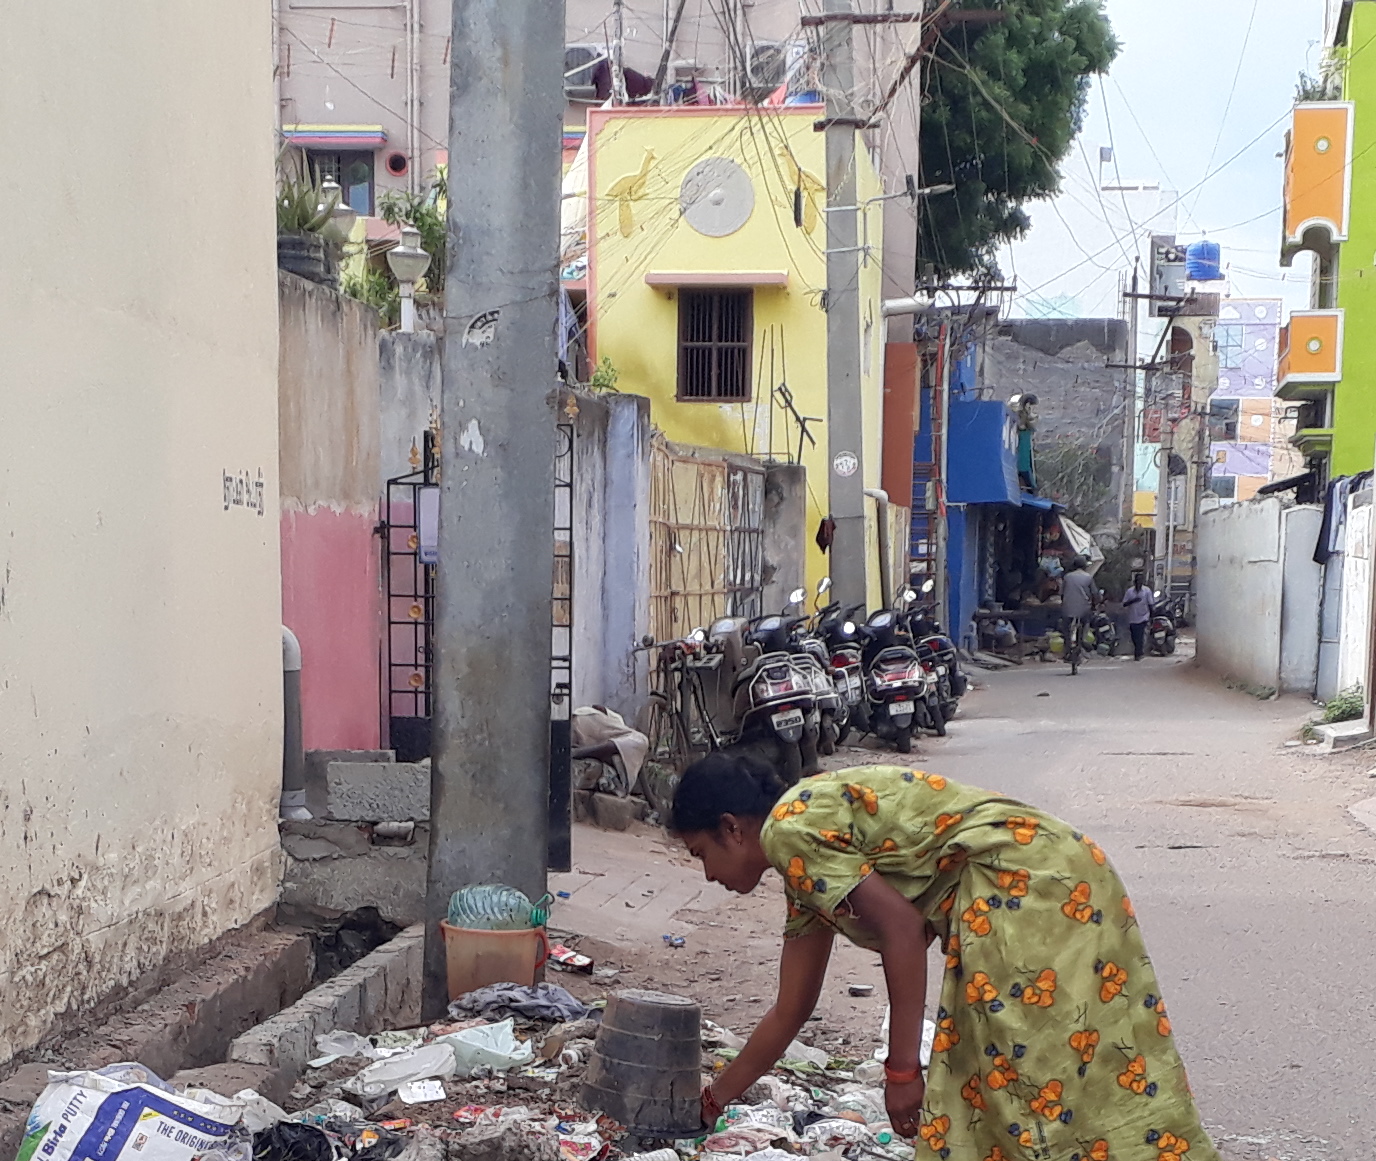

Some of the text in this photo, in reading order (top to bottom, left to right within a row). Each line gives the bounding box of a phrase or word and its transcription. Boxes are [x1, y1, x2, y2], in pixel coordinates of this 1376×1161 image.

[42, 1124, 68, 1157] Birla
[68, 1090, 88, 1124] PUTTY
[157, 1121, 214, 1151] THE ORIGIN
